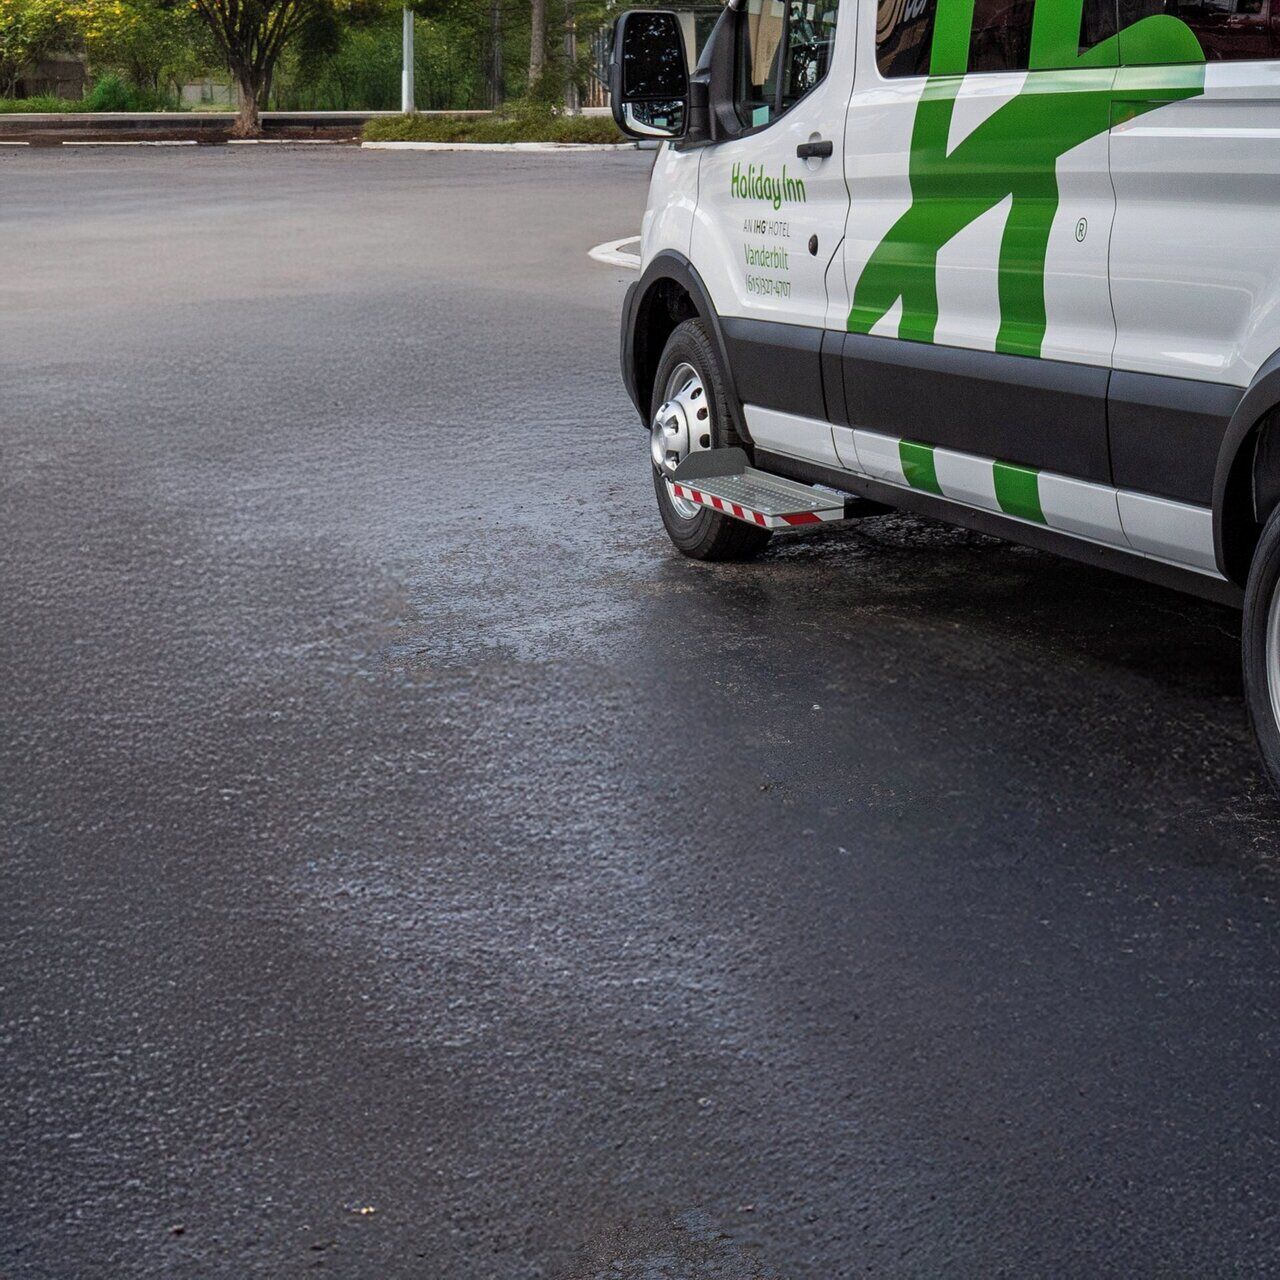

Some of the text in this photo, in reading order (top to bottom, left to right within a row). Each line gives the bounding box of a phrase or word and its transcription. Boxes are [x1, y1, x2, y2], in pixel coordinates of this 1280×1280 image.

[731, 162, 806, 211] Holiday Inn
[743, 219, 752, 233] AN
[768, 220, 791, 238] HOTEL
[743, 243, 790, 271] Vanderbilt
